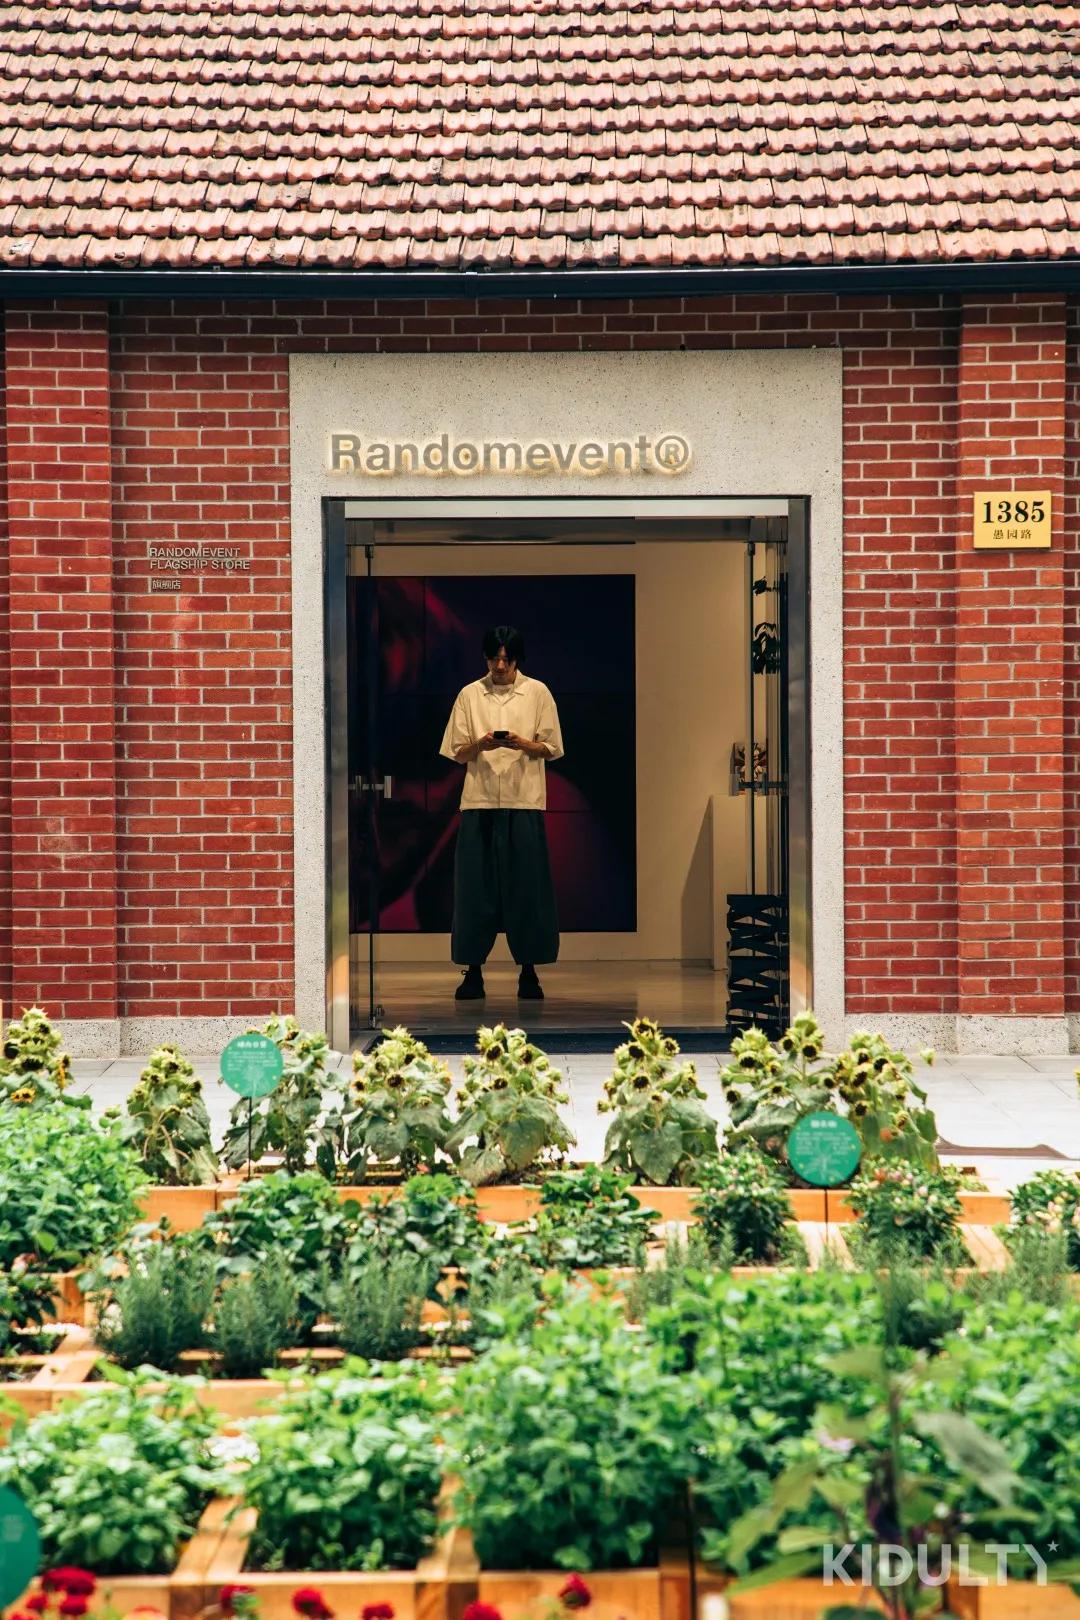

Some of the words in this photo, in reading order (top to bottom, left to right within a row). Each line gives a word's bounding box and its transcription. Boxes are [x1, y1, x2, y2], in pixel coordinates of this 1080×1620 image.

[982, 500, 1045, 523] 1385
[993, 529, 1032, 540] 愚园路
[149, 547, 240, 557] RANDOMEVENT
[150, 560, 208, 570] FLAGSHIP
[211, 560, 250, 570] STORE
[152, 580, 181, 590] 旗舰店
